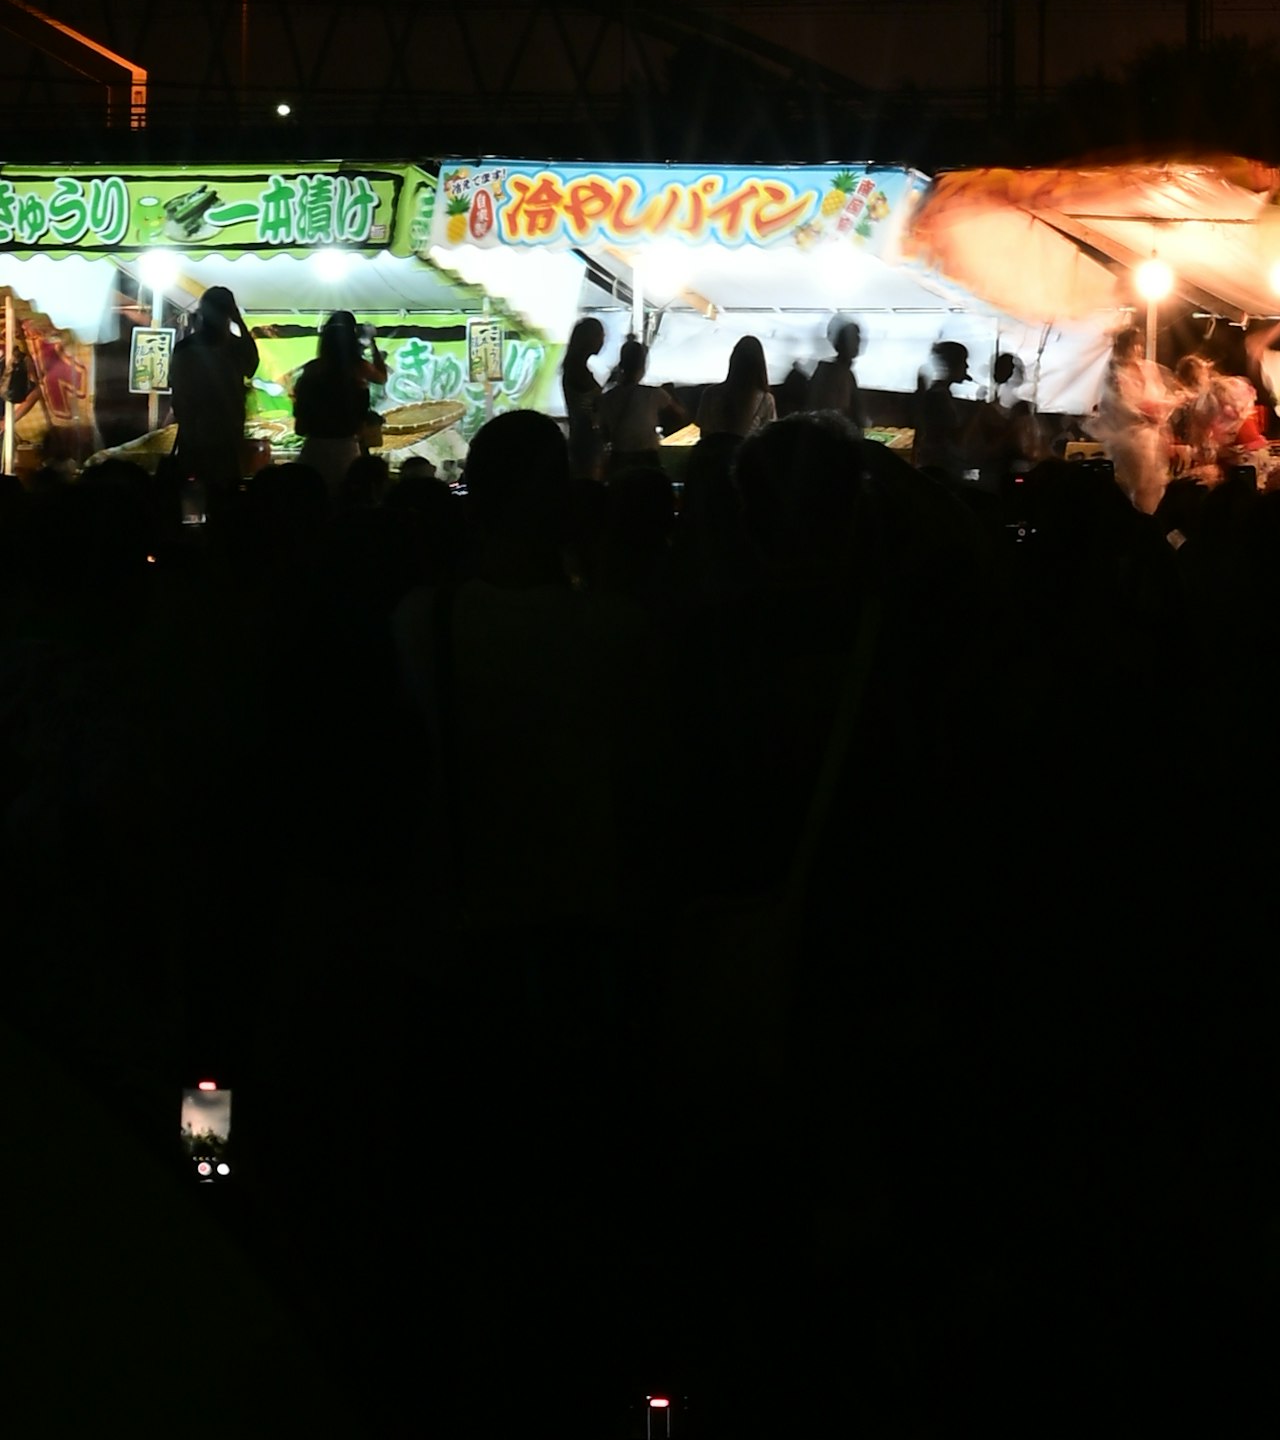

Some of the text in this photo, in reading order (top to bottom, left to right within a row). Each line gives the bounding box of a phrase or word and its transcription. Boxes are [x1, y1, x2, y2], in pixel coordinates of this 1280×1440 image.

[207, 177, 376, 242] 一本漬け
[503, 176, 812, 239] 冷やしパイン
[386, 338, 546, 402] きゅり
